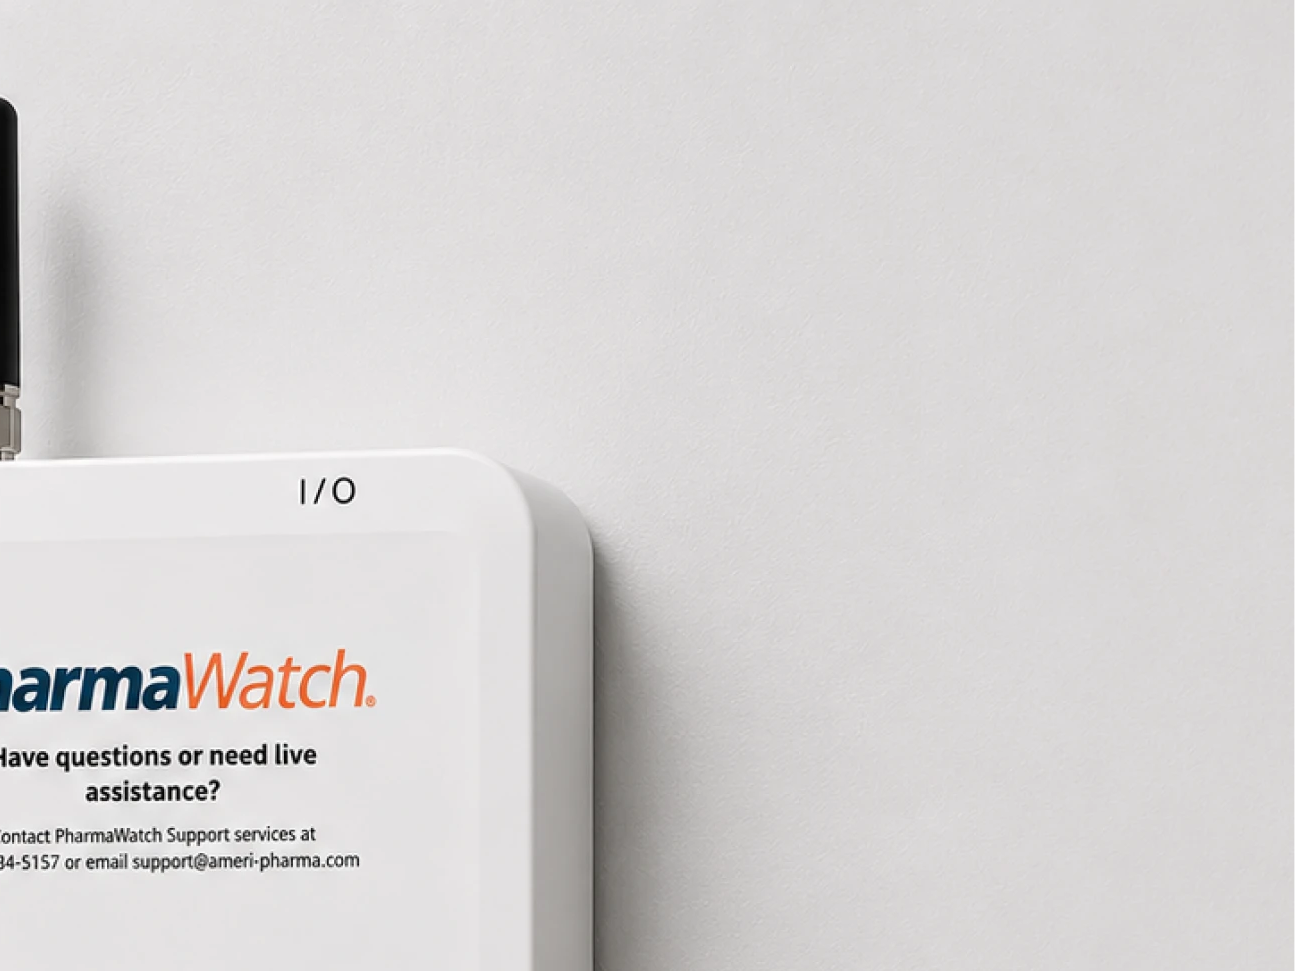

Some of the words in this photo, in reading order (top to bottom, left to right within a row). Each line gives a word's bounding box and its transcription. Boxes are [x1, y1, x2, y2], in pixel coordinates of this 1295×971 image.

[55, 743, 172, 773] questions
[177, 749, 204, 767] or
[209, 743, 268, 767] need
[274, 743, 317, 766] live
[85, 778, 221, 802] assistance?
[55, 827, 163, 844] PharmaWatch
[166, 826, 230, 847] Support
[234, 826, 296, 844] services
[300, 827, 317, 843] at
[64, 856, 81, 871] or
[85, 852, 128, 871] email
[131, 851, 360, 874] support@ameri-pharma.com
